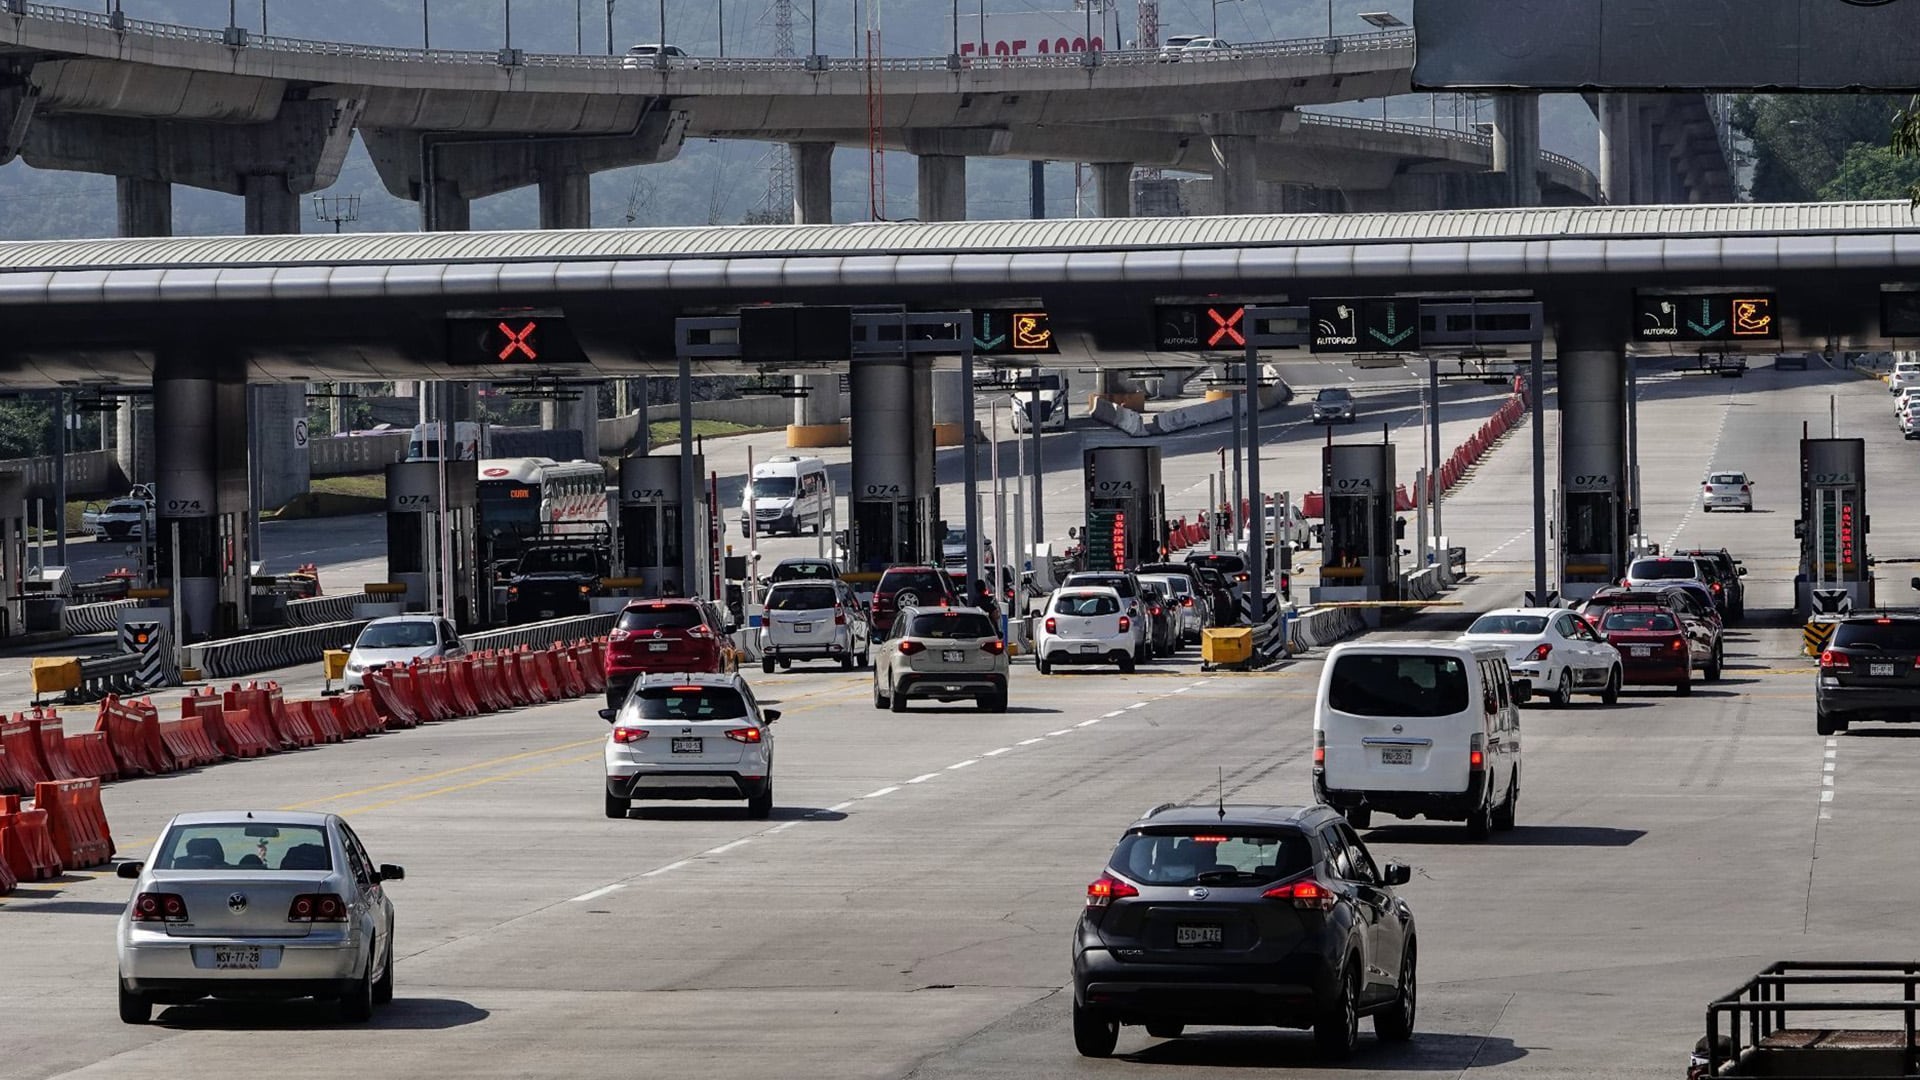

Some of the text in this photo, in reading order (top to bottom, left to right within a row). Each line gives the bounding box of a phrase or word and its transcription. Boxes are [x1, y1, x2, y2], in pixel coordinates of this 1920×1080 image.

[1163, 337, 1198, 345] AUTOPAGO
[1316, 336, 1357, 345] AUTOPAGO
[1575, 475, 1608, 485] 074
[1816, 473, 1850, 483] 074
[1099, 481, 1133, 491] 074
[1338, 478, 1371, 489] 074
[631, 489, 664, 499] 074
[867, 485, 900, 494] 074
[398, 495, 430, 504] 074
[168, 500, 201, 510] 074
[216, 952, 259, 962] NSV-77-28
